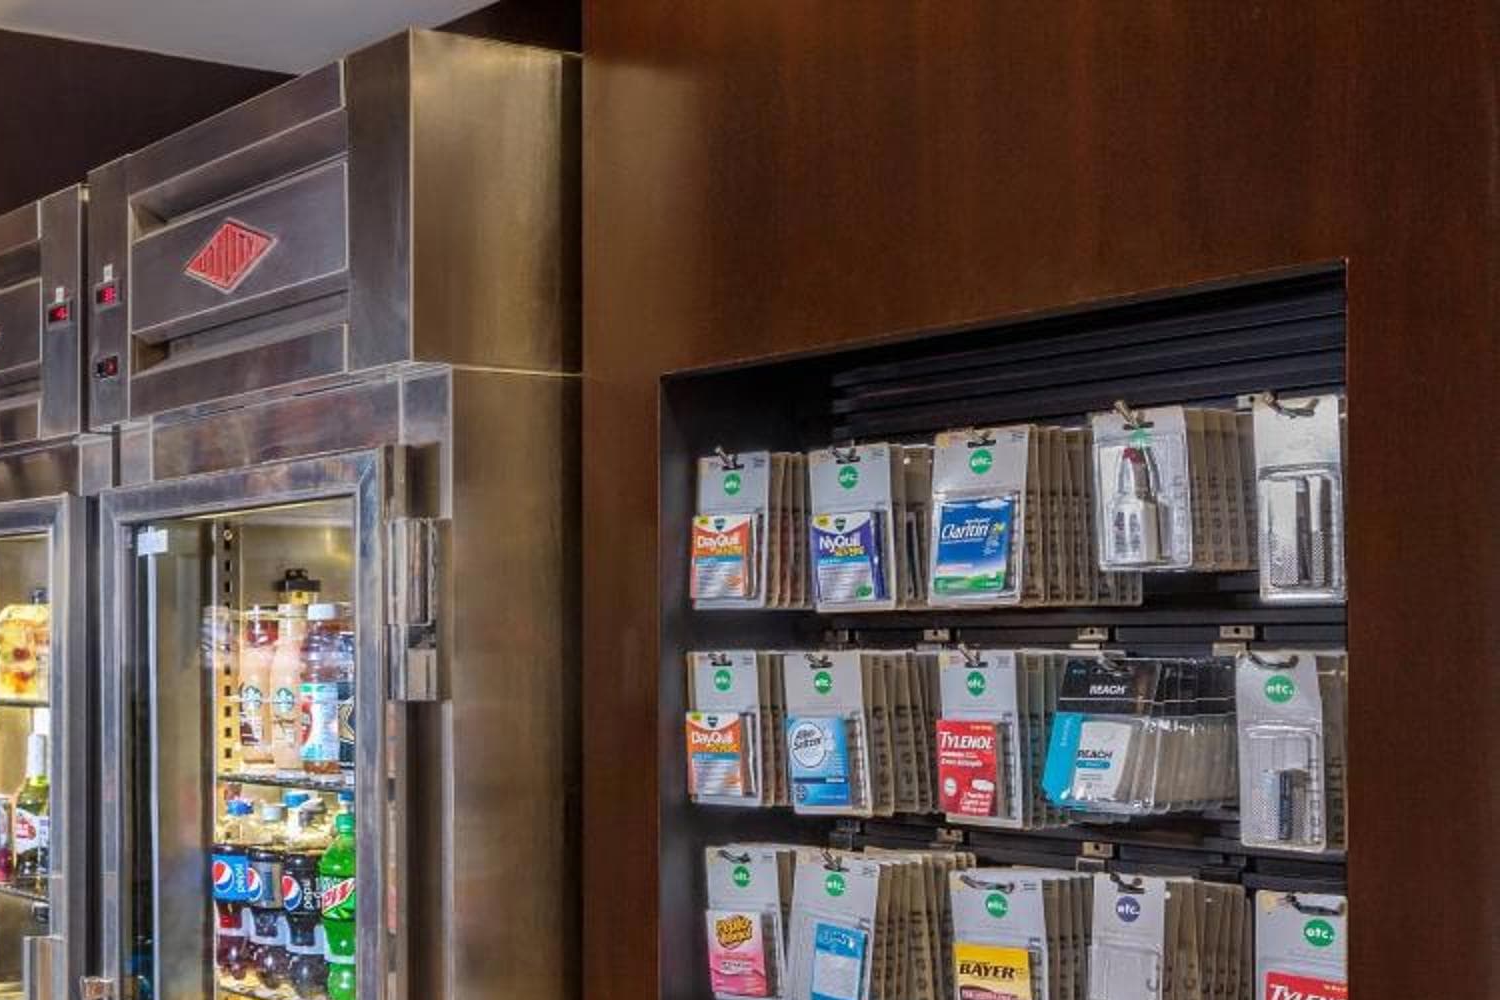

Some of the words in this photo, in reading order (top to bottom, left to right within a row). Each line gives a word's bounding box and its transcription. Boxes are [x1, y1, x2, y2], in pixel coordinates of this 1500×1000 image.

[820, 534, 860, 553] NyQuil
[1089, 684, 1126, 695] REACH
[940, 730, 994, 750] TYLENOL
[1077, 748, 1113, 759] REACH
[960, 963, 1016, 979] BAYER
